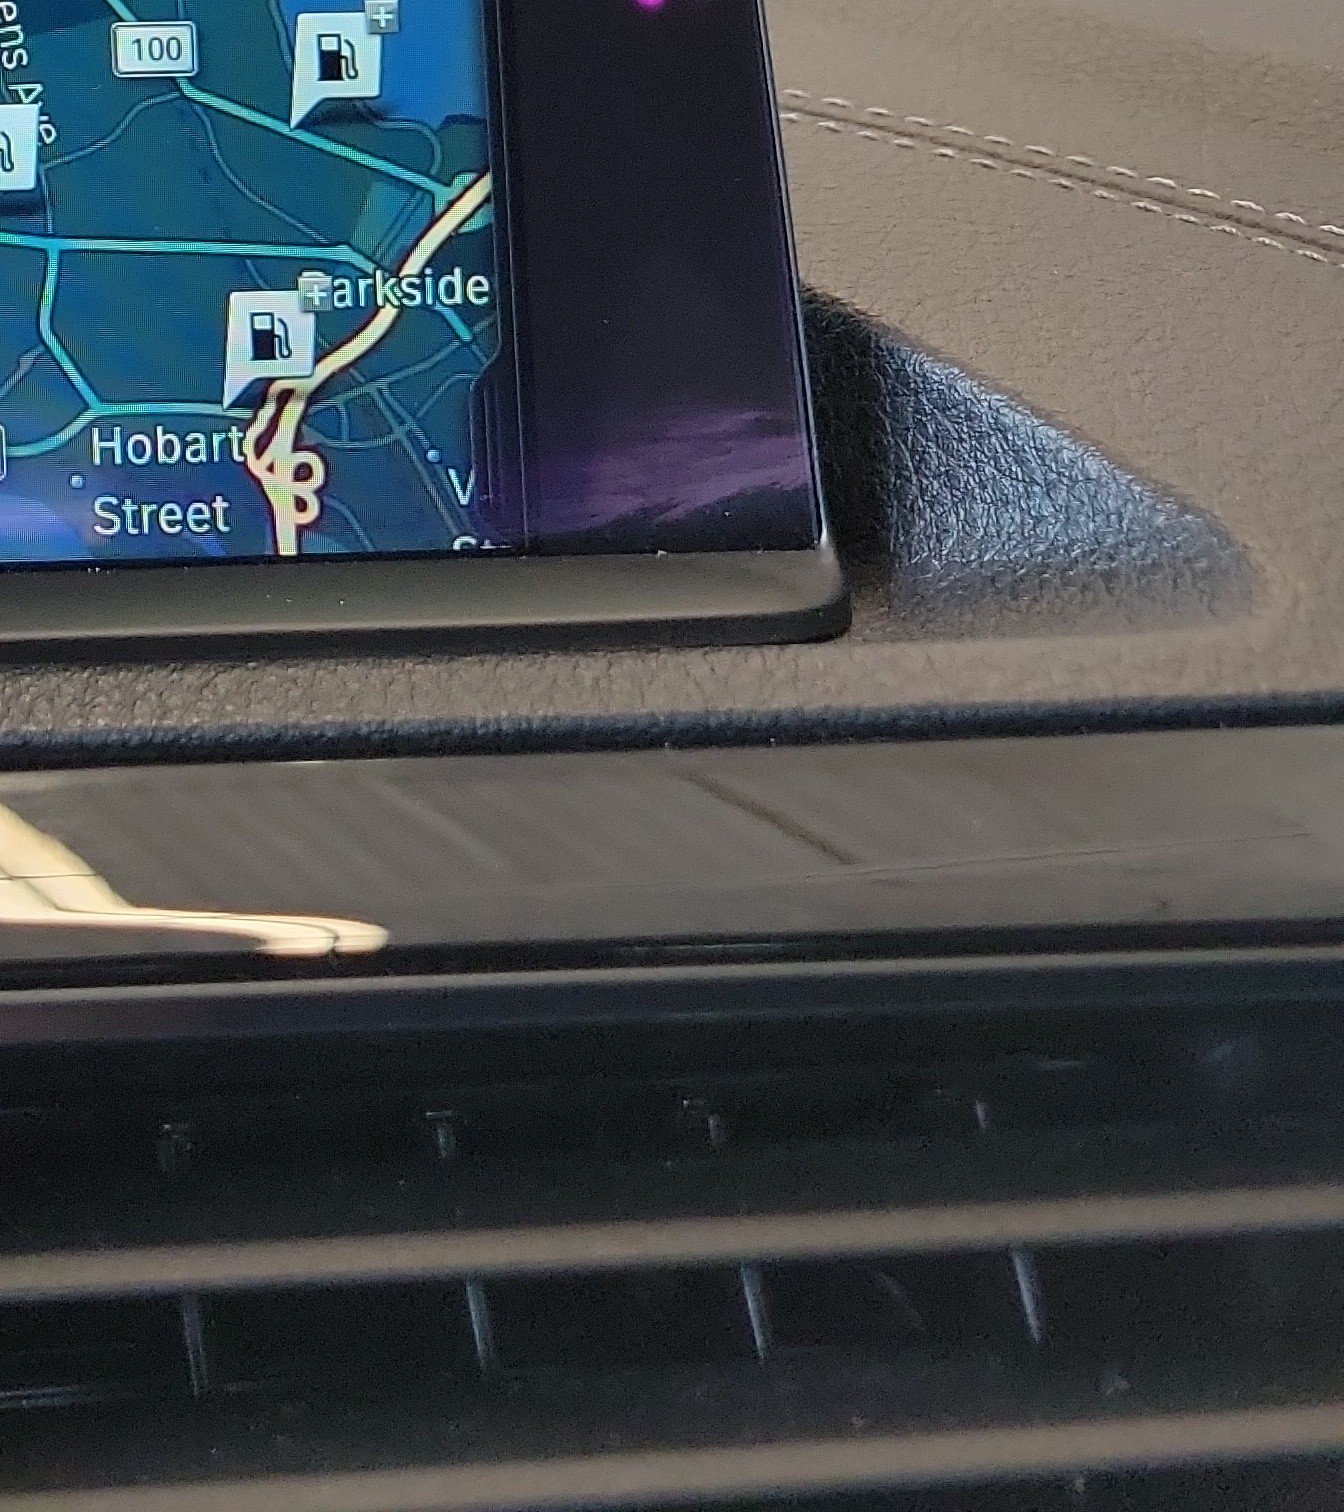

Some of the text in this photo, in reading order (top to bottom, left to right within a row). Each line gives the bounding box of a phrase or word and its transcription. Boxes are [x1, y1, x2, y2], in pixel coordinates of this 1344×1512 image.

[130, 35, 183, 63] 100
[7, 83, 58, 146] Ae
[300, 265, 491, 308] arkside
[92, 427, 246, 467] Hobart
[93, 496, 231, 537] Street
